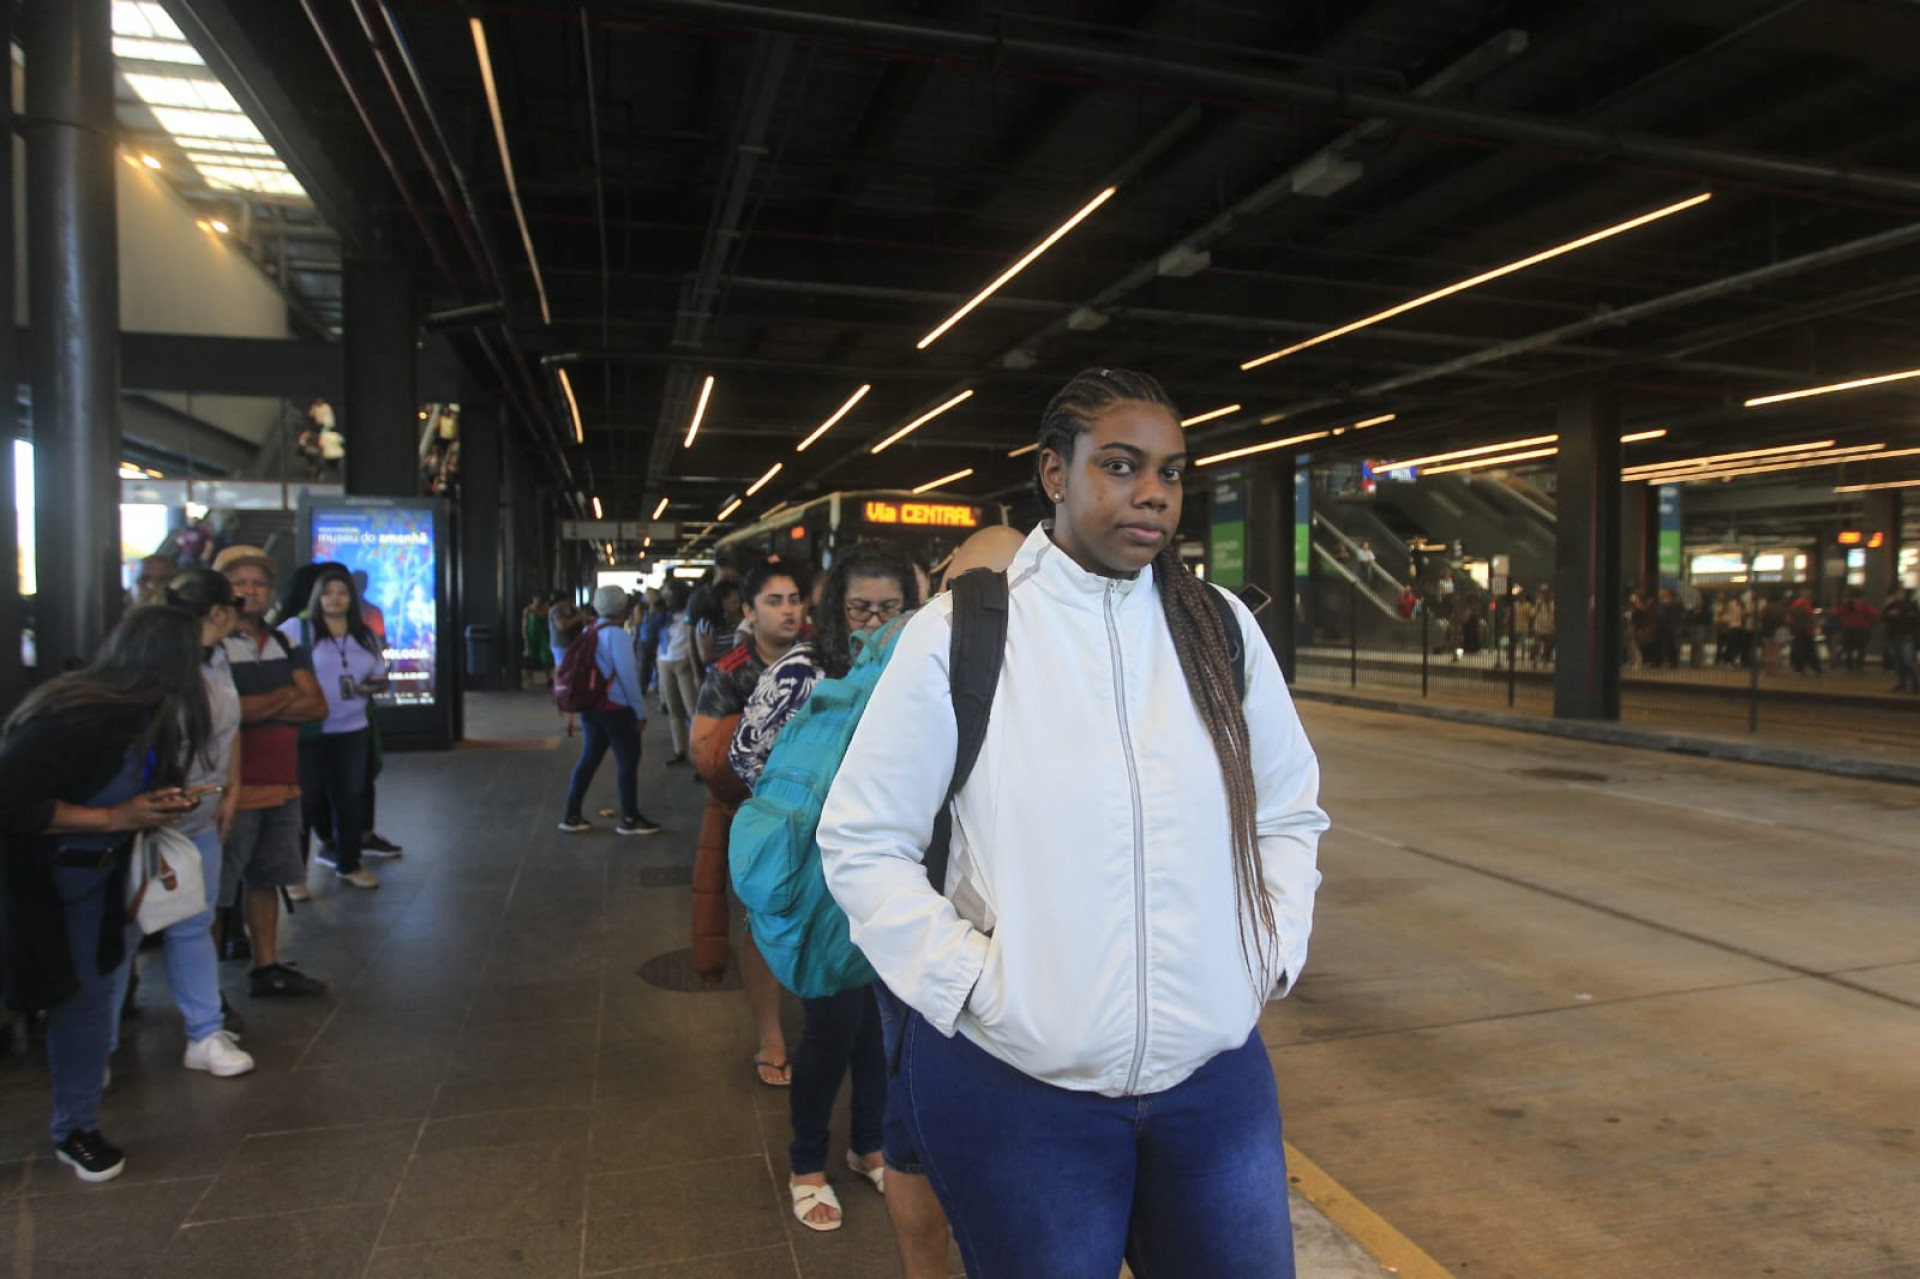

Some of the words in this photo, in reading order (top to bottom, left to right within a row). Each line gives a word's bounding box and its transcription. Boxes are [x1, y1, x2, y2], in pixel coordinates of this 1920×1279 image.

[866, 501, 897, 523] Via
[901, 503, 976, 527] CENTRAL
[318, 533, 359, 545] museu
[361, 531, 376, 545] do
[379, 530, 428, 545] amanhã
